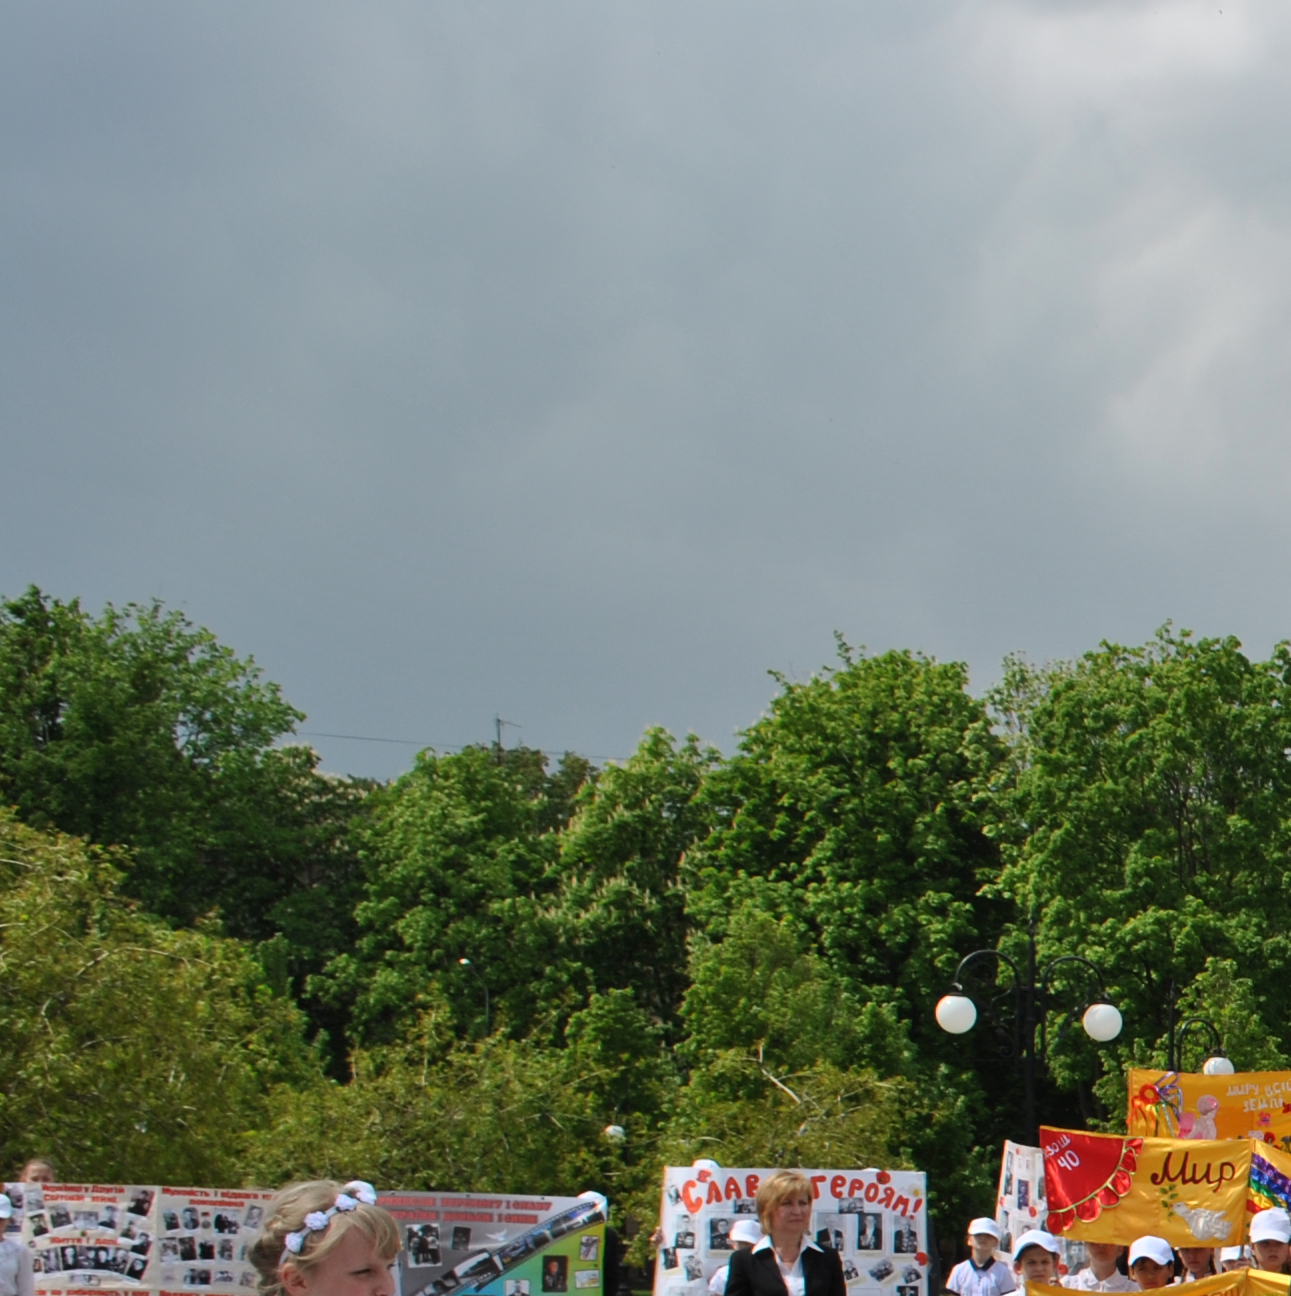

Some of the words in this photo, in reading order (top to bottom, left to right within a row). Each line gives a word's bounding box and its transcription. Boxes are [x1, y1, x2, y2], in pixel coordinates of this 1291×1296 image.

[1057, 1149, 1081, 1171] 40
[1150, 1151, 1235, 1193] Мир
[682, 1174, 760, 1214] СЛАВ
